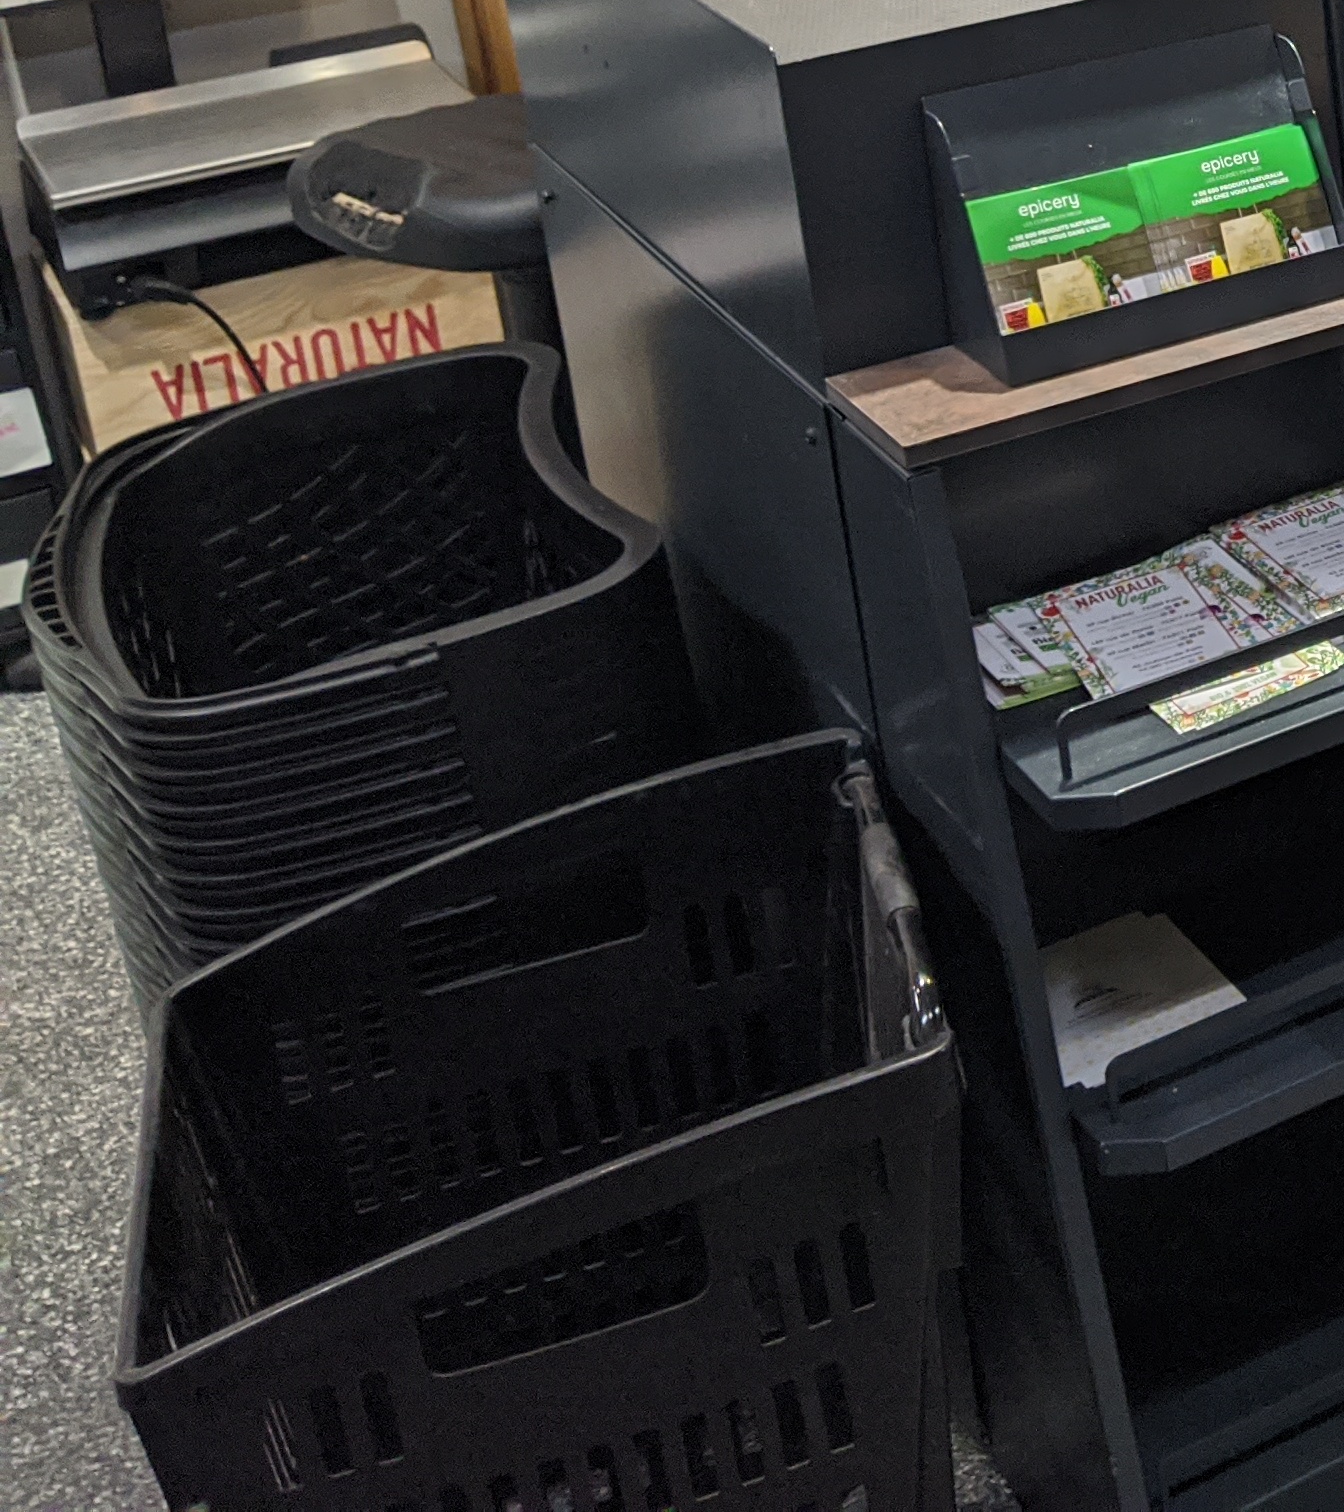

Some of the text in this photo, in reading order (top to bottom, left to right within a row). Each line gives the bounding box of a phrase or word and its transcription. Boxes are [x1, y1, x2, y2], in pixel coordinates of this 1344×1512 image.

[1018, 192, 1080, 219] epicery
[151, 303, 444, 421] NATURALIA
[1075, 574, 1171, 610] NATURALIA Vegan
